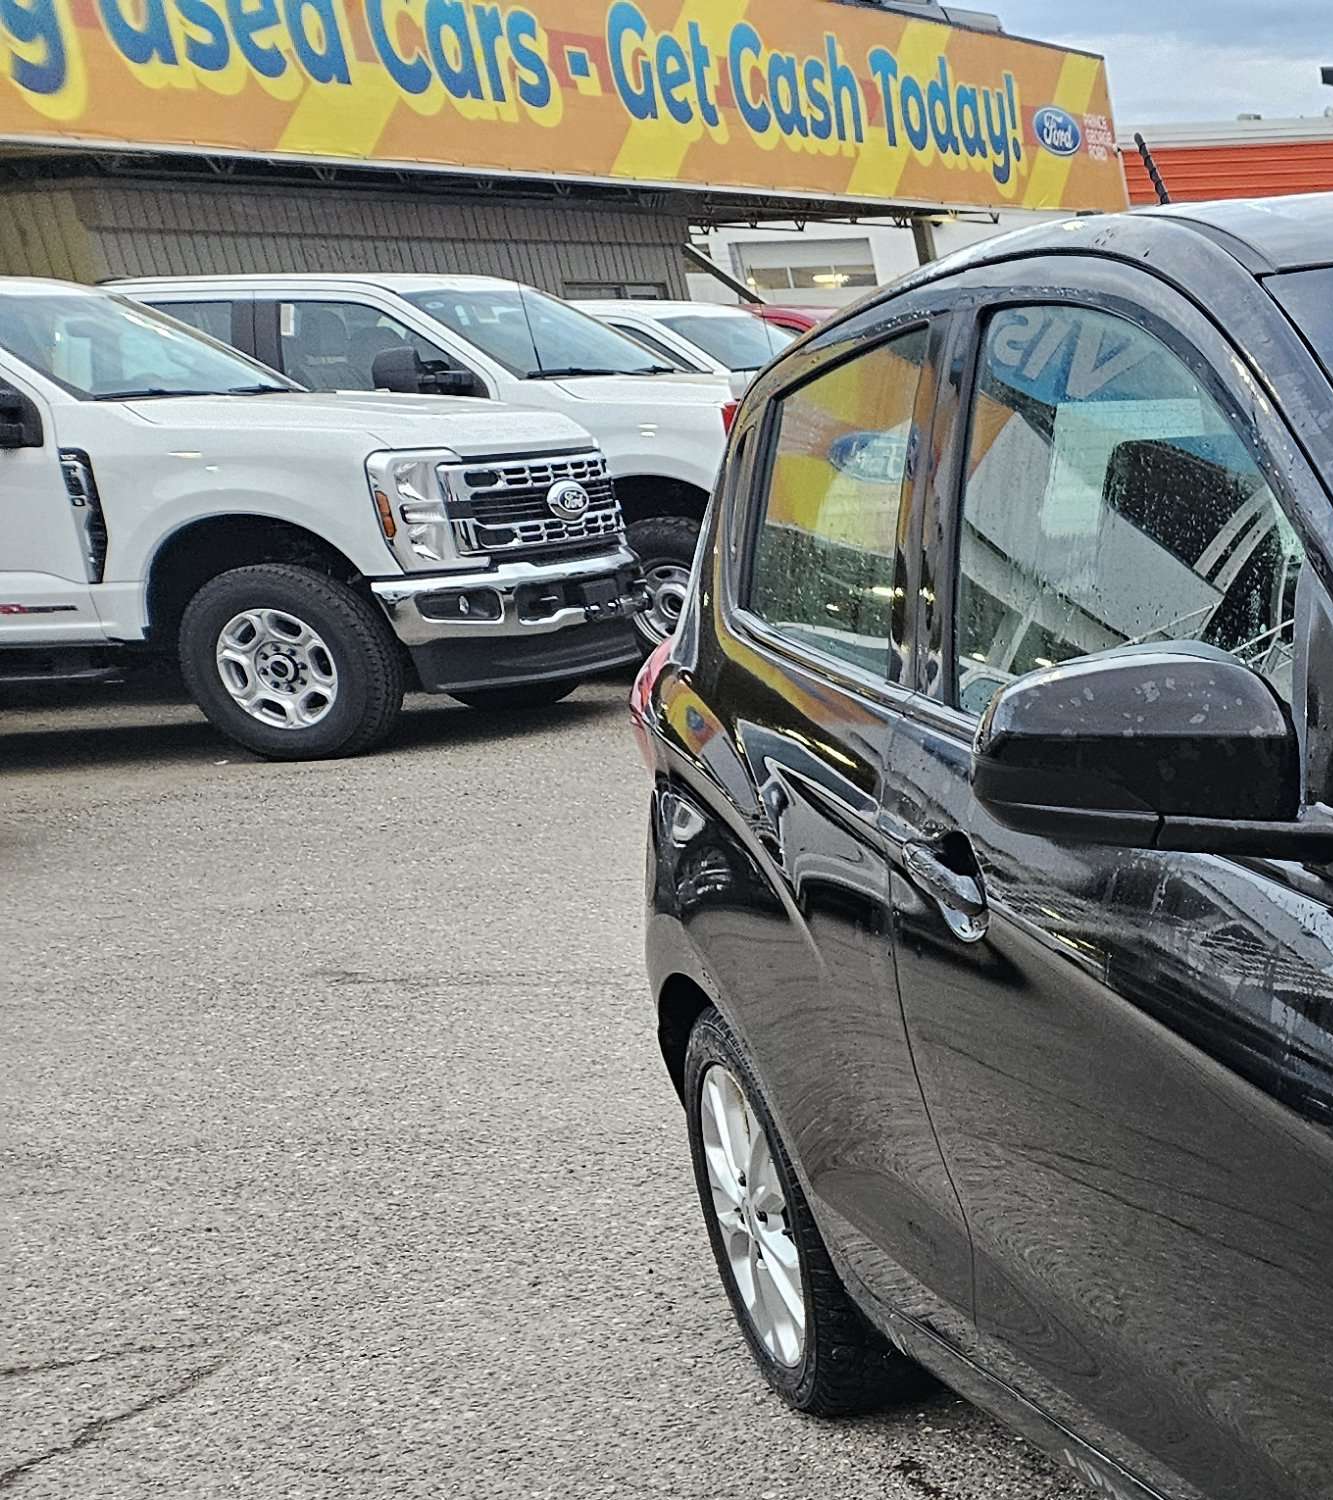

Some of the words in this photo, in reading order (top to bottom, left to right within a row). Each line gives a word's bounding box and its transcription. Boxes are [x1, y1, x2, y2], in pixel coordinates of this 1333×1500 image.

[367, 0, 551, 108] Cars
[607, 2, 719, 127] Get
[729, 23, 863, 144] Cash
[868, 48, 1022, 184] Today!
[1043, 111, 1074, 149] Ford
